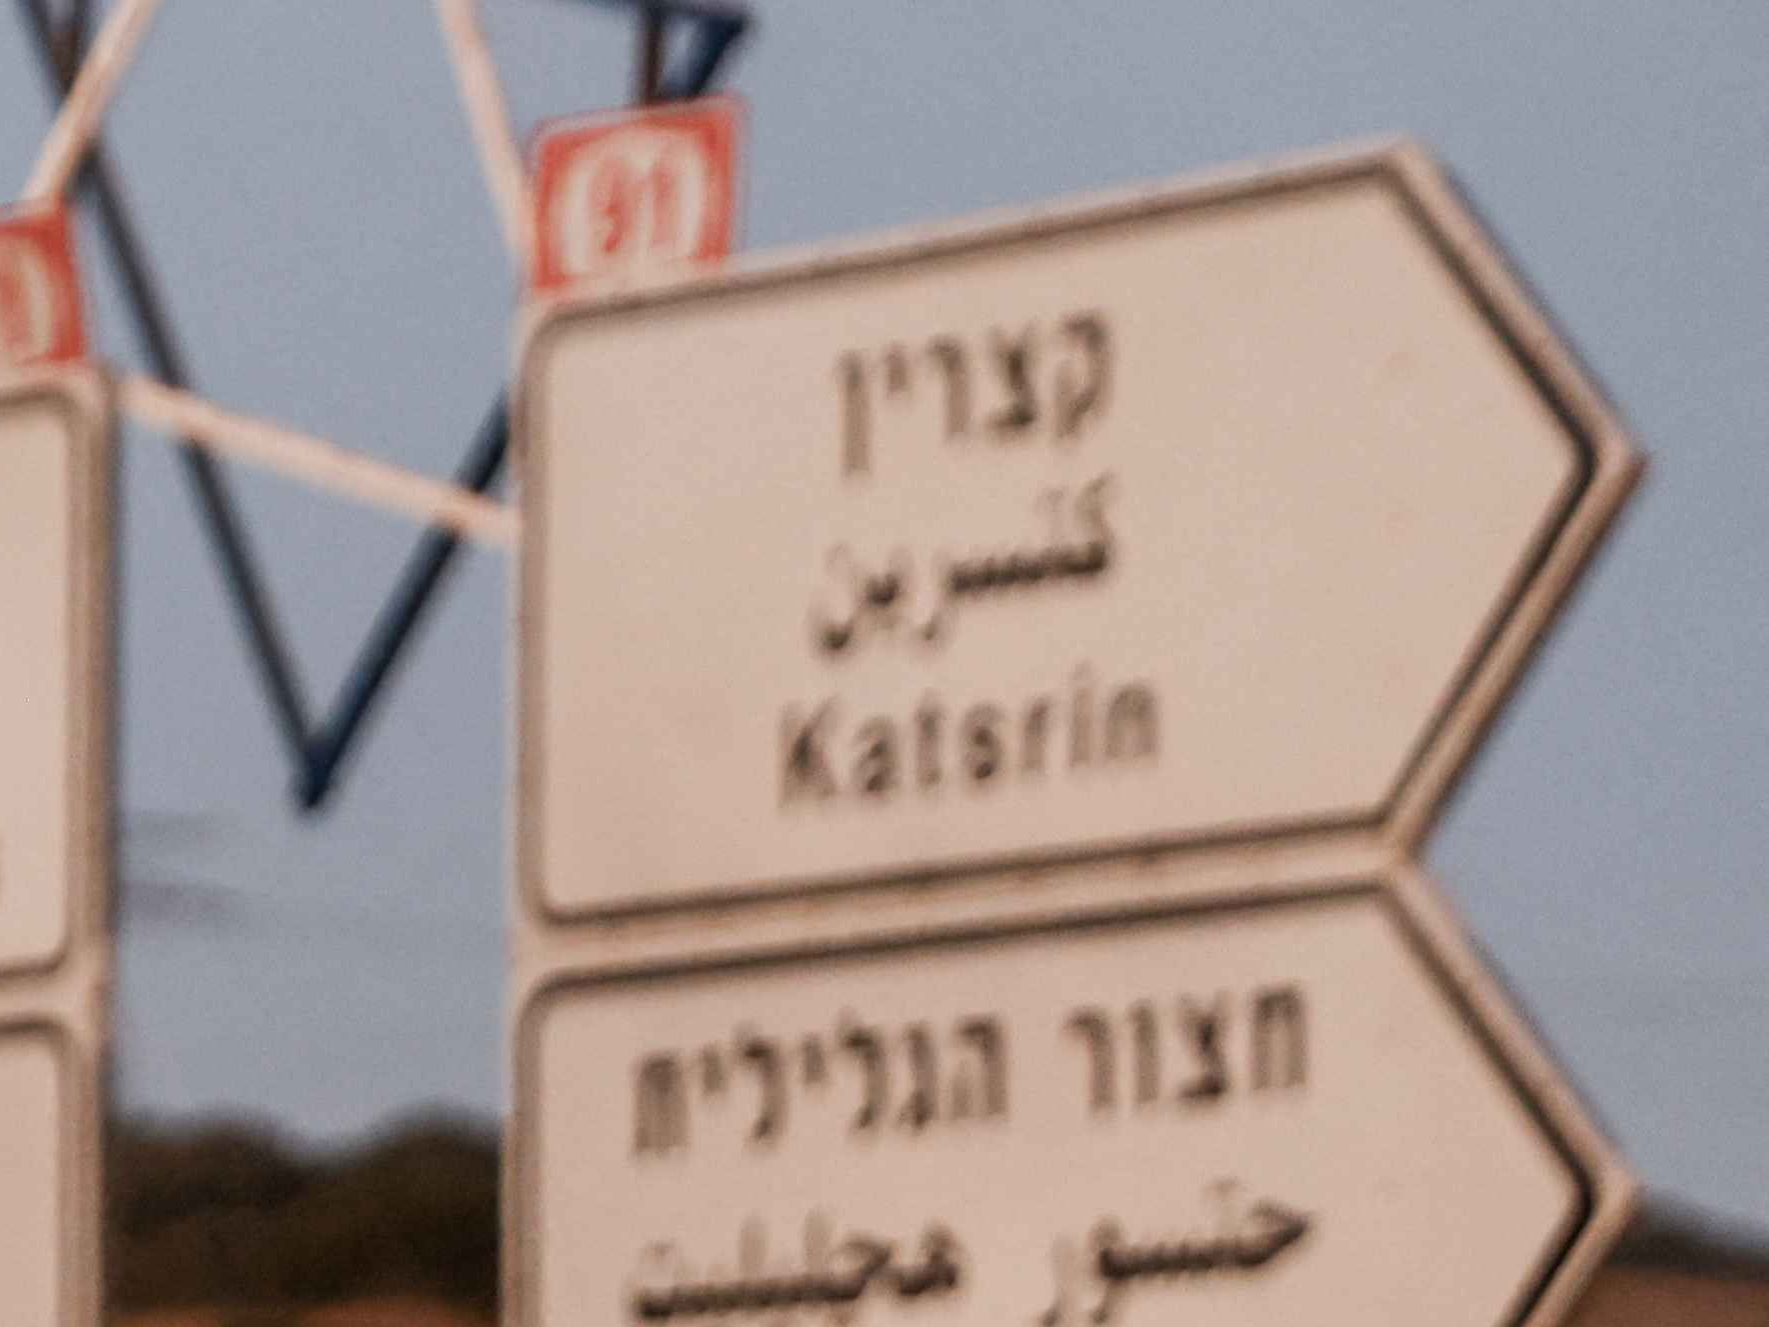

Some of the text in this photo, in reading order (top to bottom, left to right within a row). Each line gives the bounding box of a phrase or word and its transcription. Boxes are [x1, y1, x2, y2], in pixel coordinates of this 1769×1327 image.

[592, 152, 683, 260] 91
[838, 312, 1114, 476] קצרין
[780, 668, 1159, 811] Katsrin
[632, 984, 1309, 1160] חצור הגלילית
